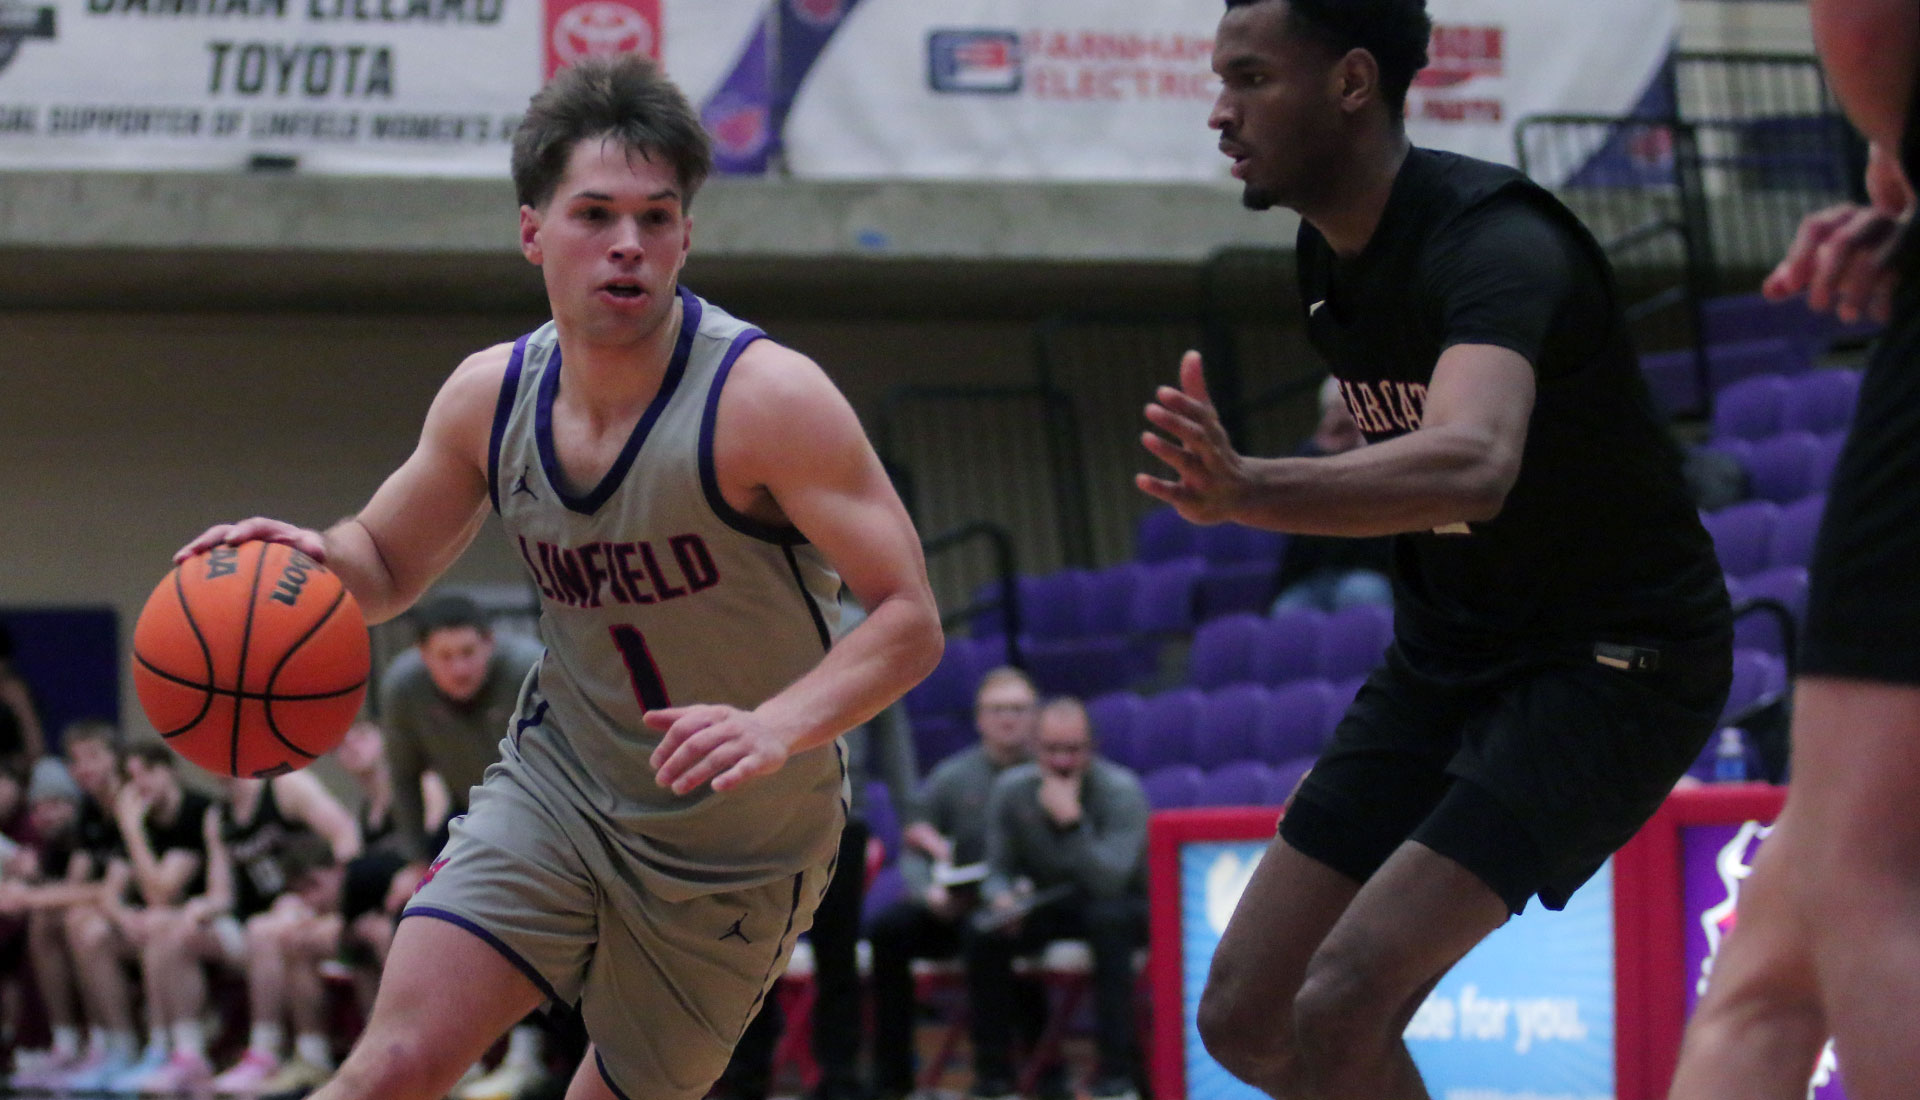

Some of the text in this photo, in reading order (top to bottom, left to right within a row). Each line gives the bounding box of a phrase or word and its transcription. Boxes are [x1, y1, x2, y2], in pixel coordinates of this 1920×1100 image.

[207, 41, 393, 96] TOYOTA
[518, 533, 720, 609] LINFIELD
[608, 623, 672, 716] 1
[1459, 984, 1509, 1041] for
